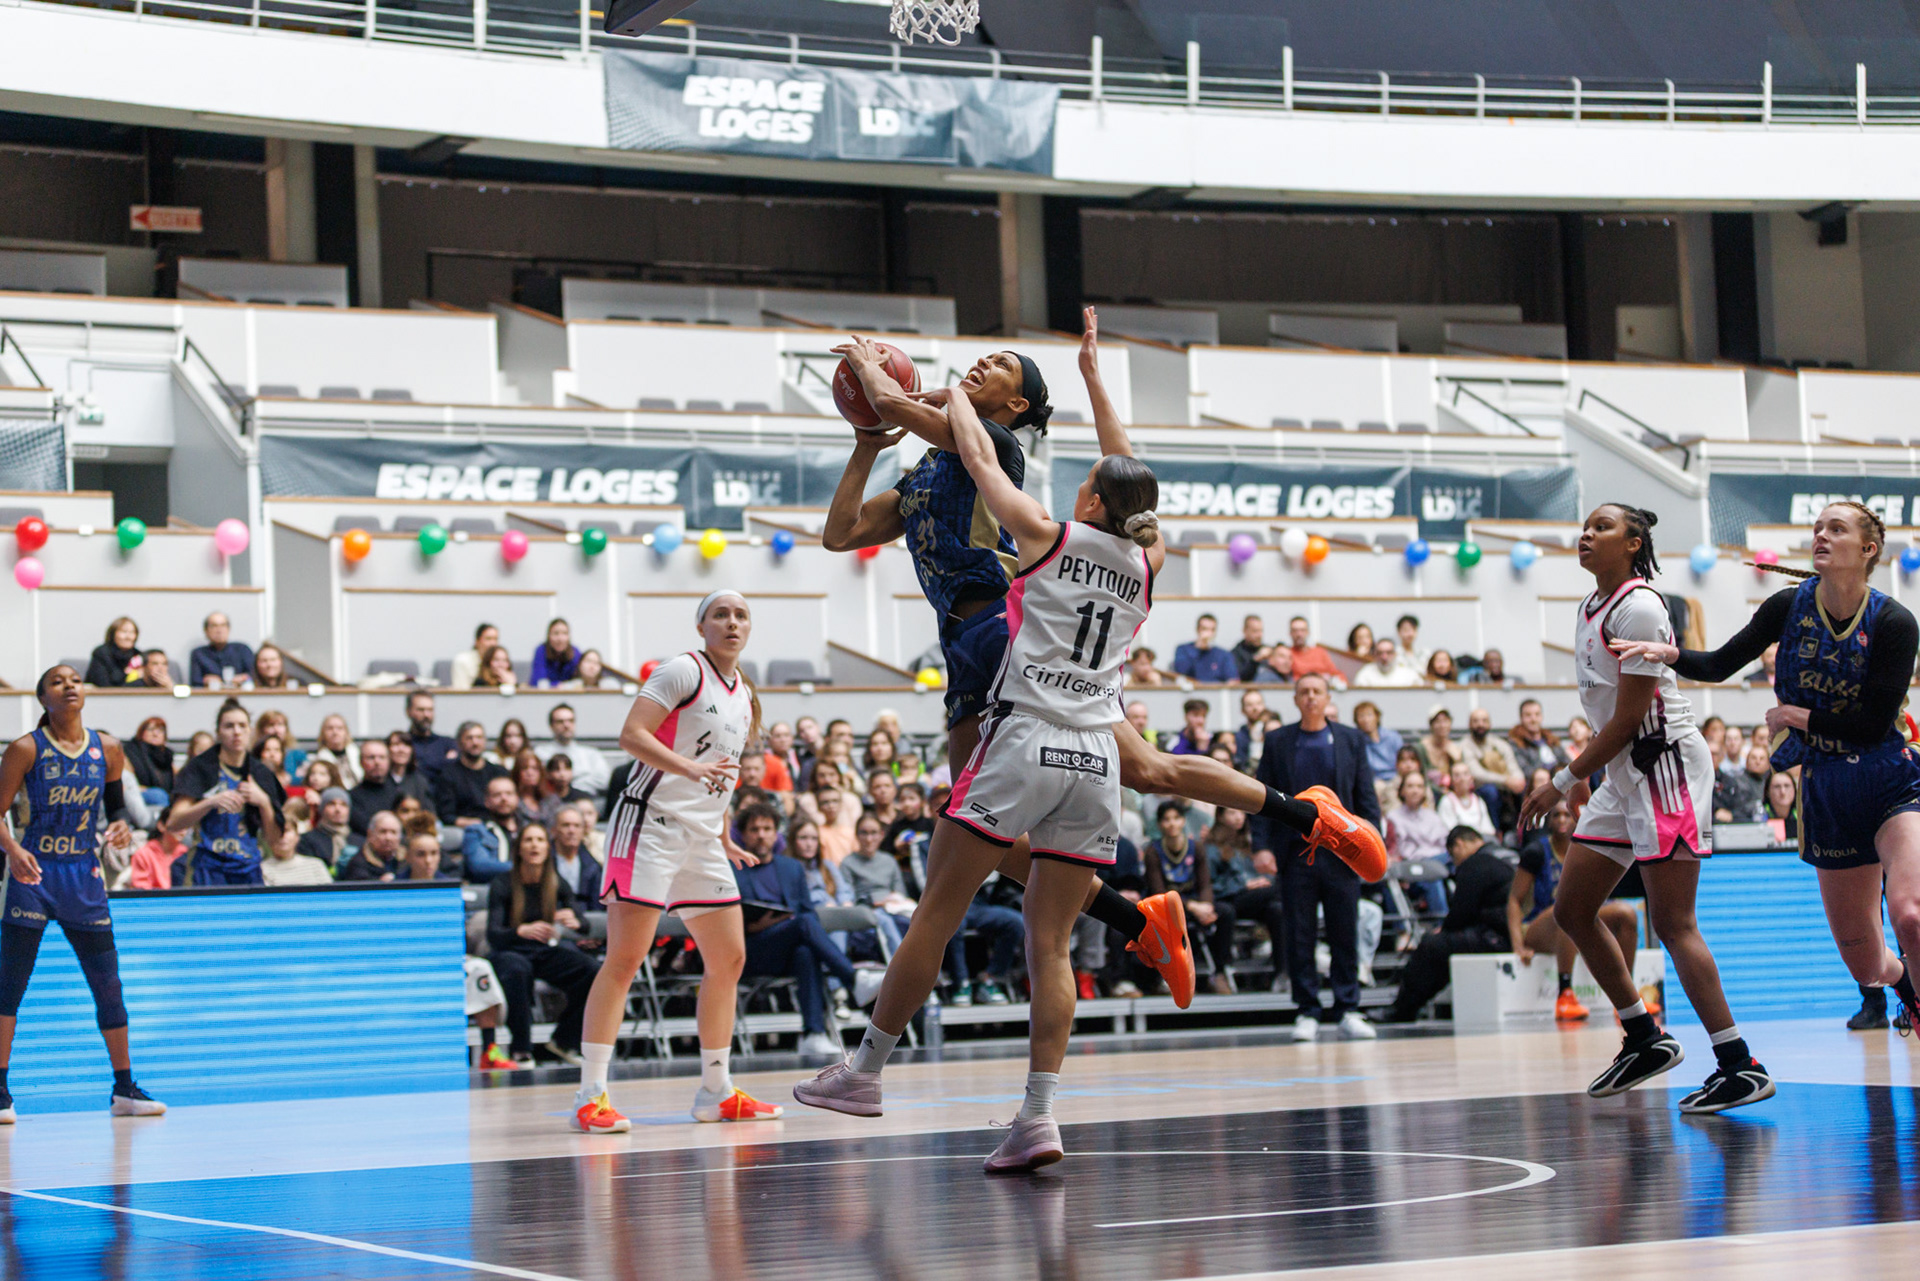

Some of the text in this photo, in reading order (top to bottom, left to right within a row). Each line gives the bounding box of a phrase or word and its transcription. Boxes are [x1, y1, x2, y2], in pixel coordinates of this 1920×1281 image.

[683, 74, 826, 114] ESPACE
[698, 106, 814, 145] LOGES
[375, 463, 680, 504] ESPACE LOGES
[713, 480, 781, 506] LDLC
[1155, 481, 1396, 519] ESPACE LOGES
[1422, 496, 1482, 521] LDLC
[1058, 555, 1141, 604] PEYTOUR
[1069, 600, 1114, 671] 11
[1045, 751, 1104, 771] RENT CAR
[48, 785, 99, 807] BLMA
[76, 809, 90, 832] 2
[39, 835, 81, 855] GGL
[1822, 847, 1858, 858] VEOLIA
